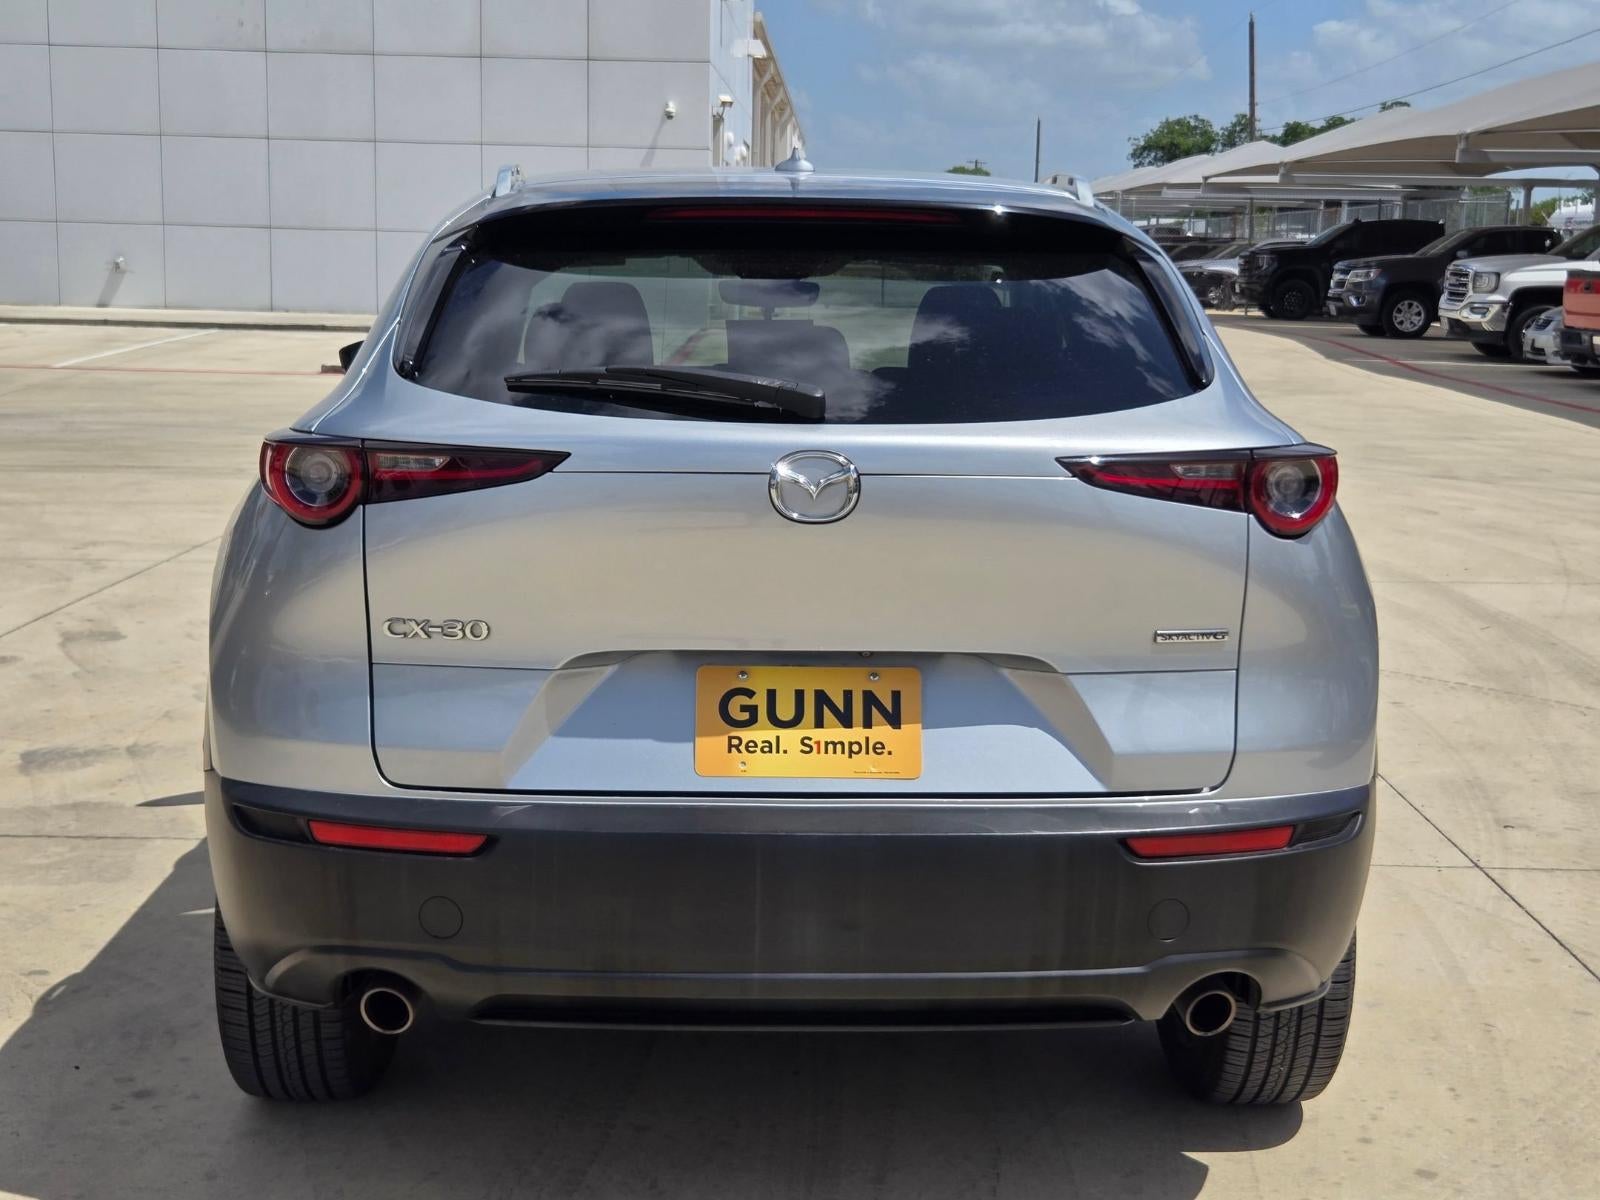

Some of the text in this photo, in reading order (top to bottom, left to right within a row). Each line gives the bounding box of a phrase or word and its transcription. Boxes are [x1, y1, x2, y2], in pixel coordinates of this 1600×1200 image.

[383, 617, 490, 640] CX-30
[718, 686, 902, 730] GUNN
[727, 735, 788, 754] Real.
